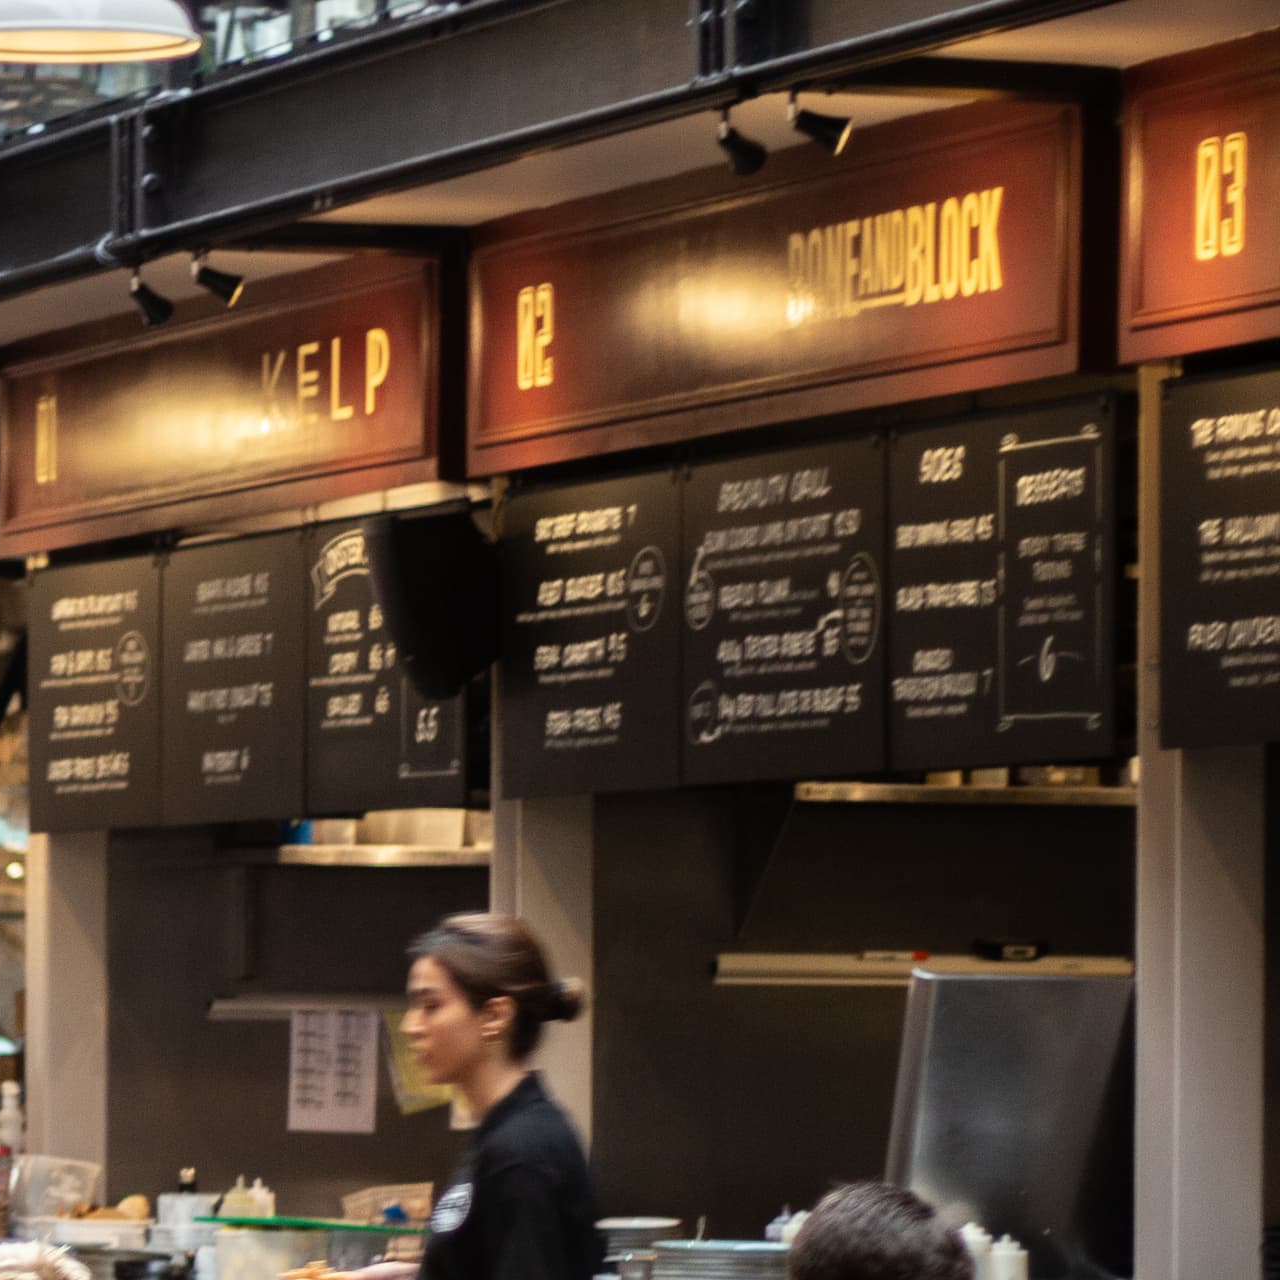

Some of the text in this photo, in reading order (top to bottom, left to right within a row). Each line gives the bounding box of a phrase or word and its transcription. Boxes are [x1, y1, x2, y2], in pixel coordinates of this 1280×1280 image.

[1195, 130, 1248, 261] 03
[261, 327, 391, 428] KELP
[517, 282, 554, 391] 02
